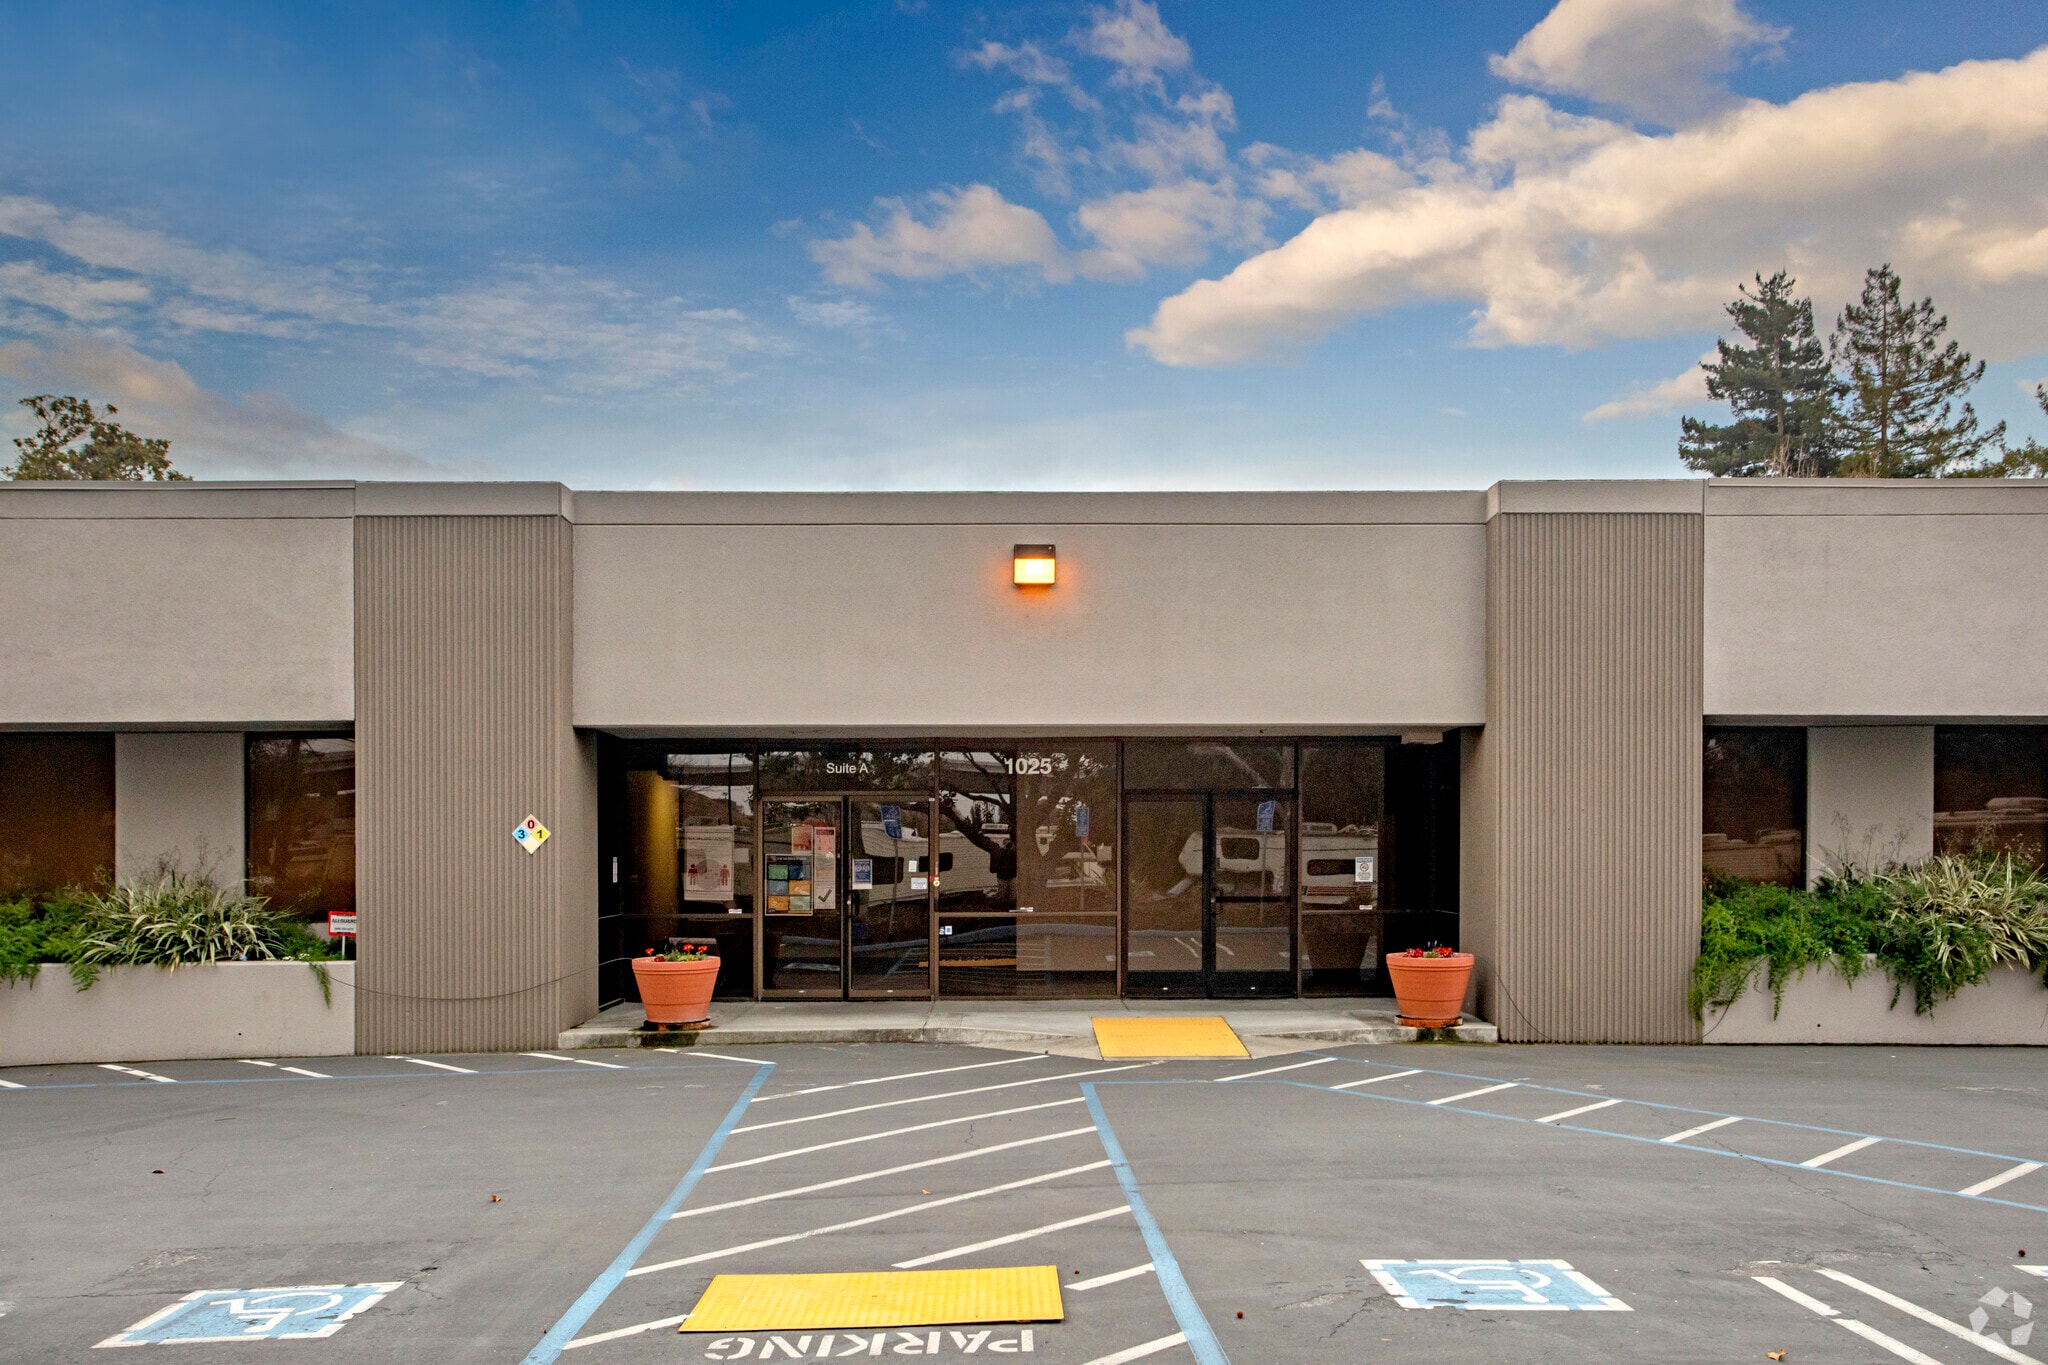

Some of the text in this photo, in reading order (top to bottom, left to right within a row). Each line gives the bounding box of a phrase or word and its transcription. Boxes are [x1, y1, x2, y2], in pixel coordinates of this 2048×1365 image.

[826, 762, 869, 774] Suite A
[1004, 757, 1052, 775] 1025
[527, 819, 535, 829] 0
[518, 829, 526, 839] 3
[537, 829, 543, 839] 1
[703, 1329, 1034, 1361] PARKING
